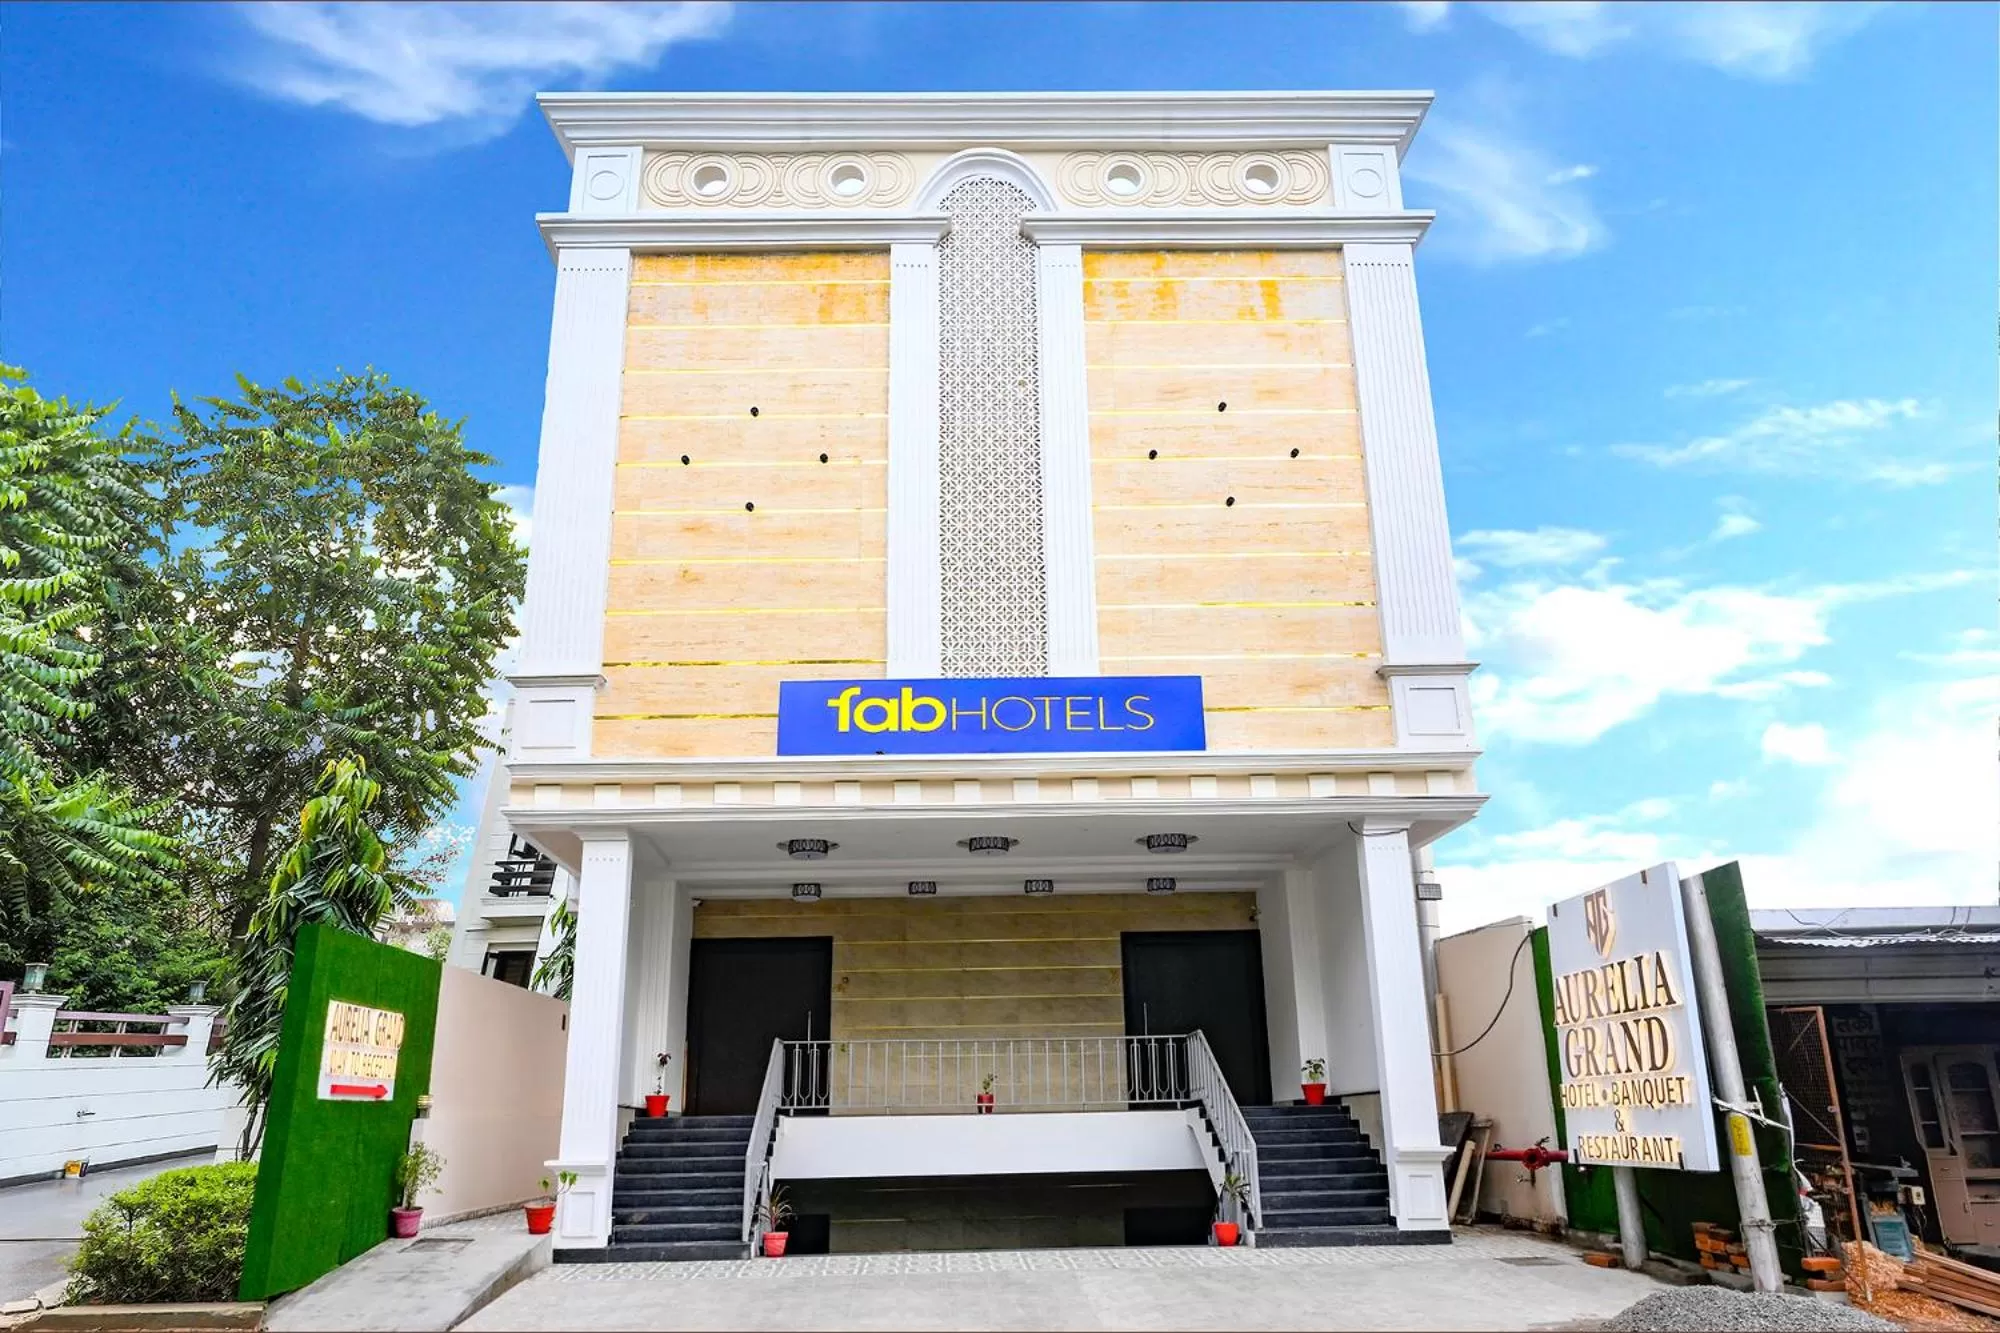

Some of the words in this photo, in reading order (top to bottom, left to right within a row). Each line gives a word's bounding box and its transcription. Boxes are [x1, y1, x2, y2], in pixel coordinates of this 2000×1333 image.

[1554, 951, 1677, 1026] AURELIA
[331, 1004, 370, 1043] AURELIA
[1565, 1016, 1669, 1078] GRAND
[1560, 1083, 1599, 1107] HOTEL
[1612, 1077, 1684, 1108] BANQUET
[1614, 1109, 1625, 1132] &
[1578, 1136, 1673, 1162] RESTAURANT
